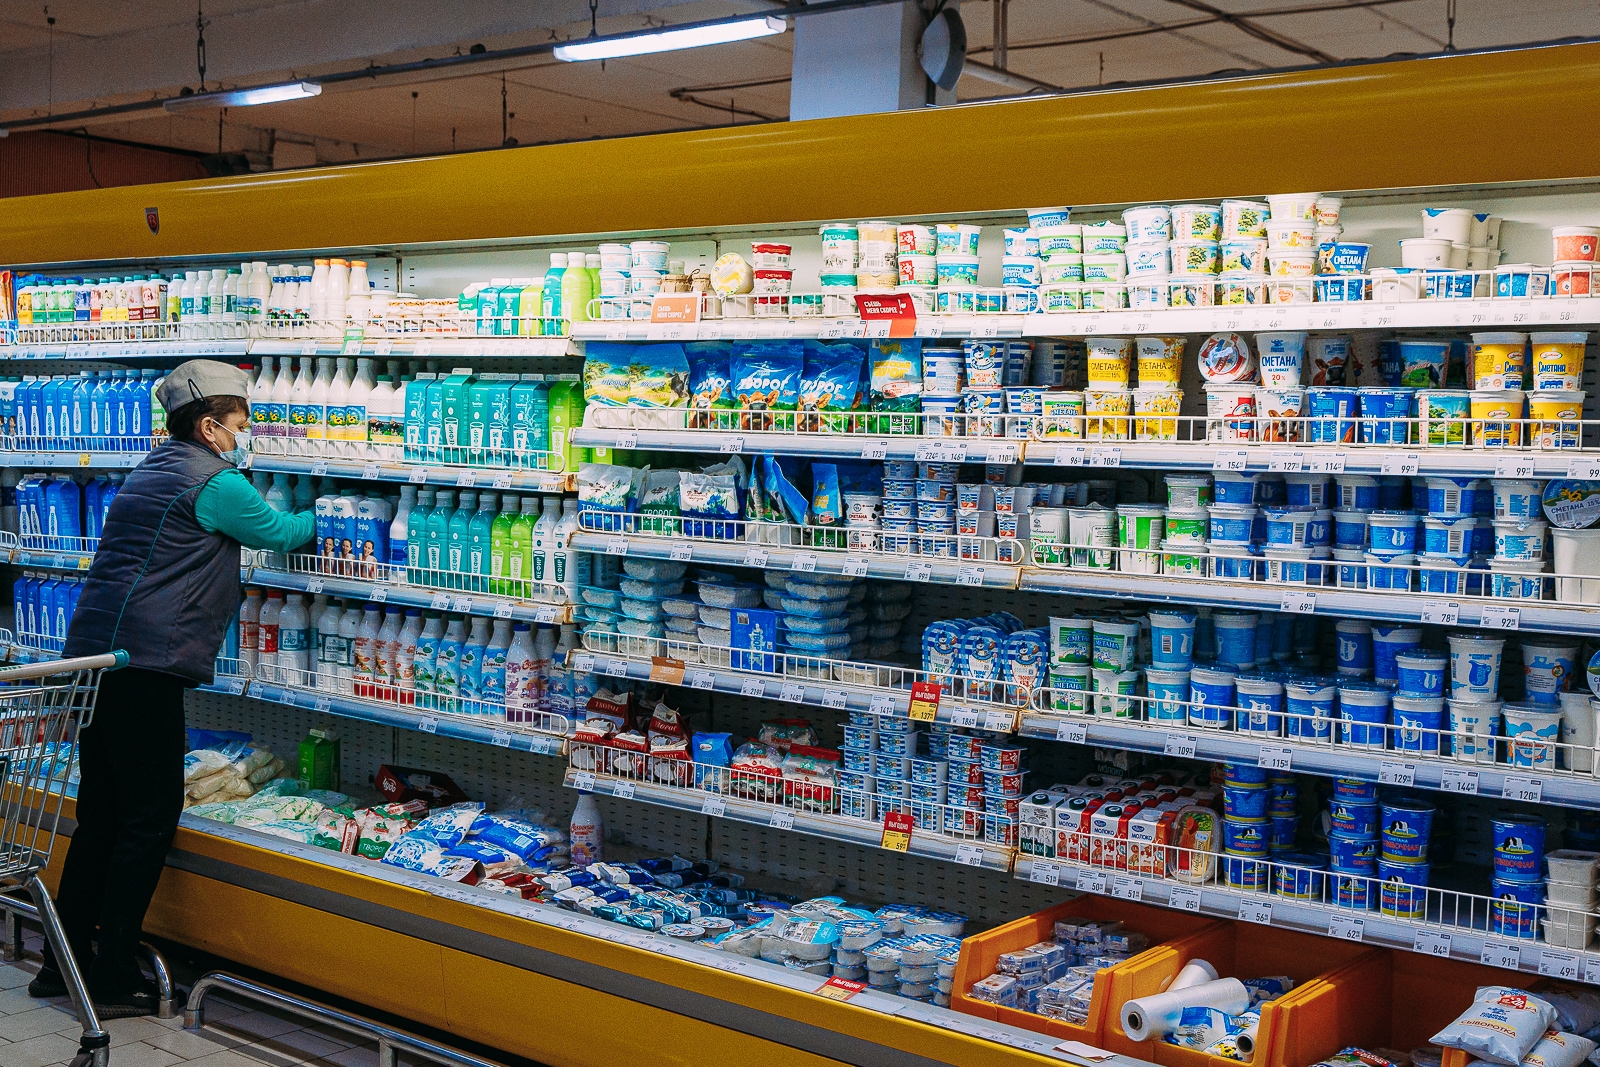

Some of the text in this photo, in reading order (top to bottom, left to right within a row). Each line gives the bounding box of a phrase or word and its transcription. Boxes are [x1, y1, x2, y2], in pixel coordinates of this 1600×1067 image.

[1334, 255, 1361, 265] СМЕТАНА
[864, 300, 881, 308] СЪЕШЬ
[1472, 314, 1481, 323] 79
[1513, 314, 1523, 322] 52
[1560, 312, 1570, 320] 58
[1269, 320, 1278, 328] 46
[1323, 319, 1332, 327] 66
[1378, 317, 1387, 325] 79
[878, 329, 886, 337] 63
[930, 328, 938, 336] 79
[985, 328, 992, 336] 56
[1262, 355, 1297, 366] СМЕТАНА
[1091, 362, 1121, 371] СМЕТАНА
[1111, 371, 1120, 379] 15%
[624, 440, 633, 448] 223
[872, 450, 882, 458] 173
[998, 454, 1009, 462] 110
[1070, 456, 1078, 465] 96
[1103, 457, 1114, 465] 106
[1227, 461, 1240, 470] 154
[1283, 462, 1296, 471] 127
[1325, 462, 1338, 471] 114
[1400, 465, 1411, 474] 99
[1516, 467, 1526, 476] 99
[1589, 469, 1600, 478] 99
[1551, 503, 1585, 514] СМЕТАНА
[967, 576, 978, 584] 114
[1299, 603, 1308, 612] 69
[1441, 614, 1451, 622] 78
[1501, 619, 1511, 627] 92
[1094, 640, 1119, 649] МЕТАНА
[915, 691, 936, 700] ВЫГОДНО
[920, 712, 930, 720] 137
[996, 722, 1006, 730] 195
[1069, 732, 1080, 741] 125
[1178, 746, 1190, 755] 109
[1272, 759, 1285, 767] 115
[1394, 773, 1407, 783] 129
[795, 782, 820, 792] ВОРОГ
[1457, 782, 1471, 791] 144
[1519, 791, 1534, 800] 120
[888, 821, 909, 831] ВЫГОДНО
[1058, 820, 1078, 829] МОЛОКО
[1094, 827, 1115, 836] МОЛОКО
[1131, 832, 1153, 841] МОЛОКО
[896, 842, 903, 850] 59
[1382, 840, 1419, 852] СЛИВОЧНАЯ
[1494, 857, 1535, 868] СЛИВОЧНАЯ
[1045, 874, 1054, 883] 51
[1091, 882, 1100, 891] 50
[1128, 889, 1136, 898] 51
[1185, 900, 1194, 909] 85
[1256, 912, 1264, 921] 56
[1346, 929, 1356, 938] 62
[1433, 945, 1443, 955] 84
[1501, 957, 1511, 966] 91
[1560, 967, 1570, 976] 49
[833, 978, 861, 989] ВЫГОДНО
[1460, 1018, 1516, 1038] СЫВОРОТКА
